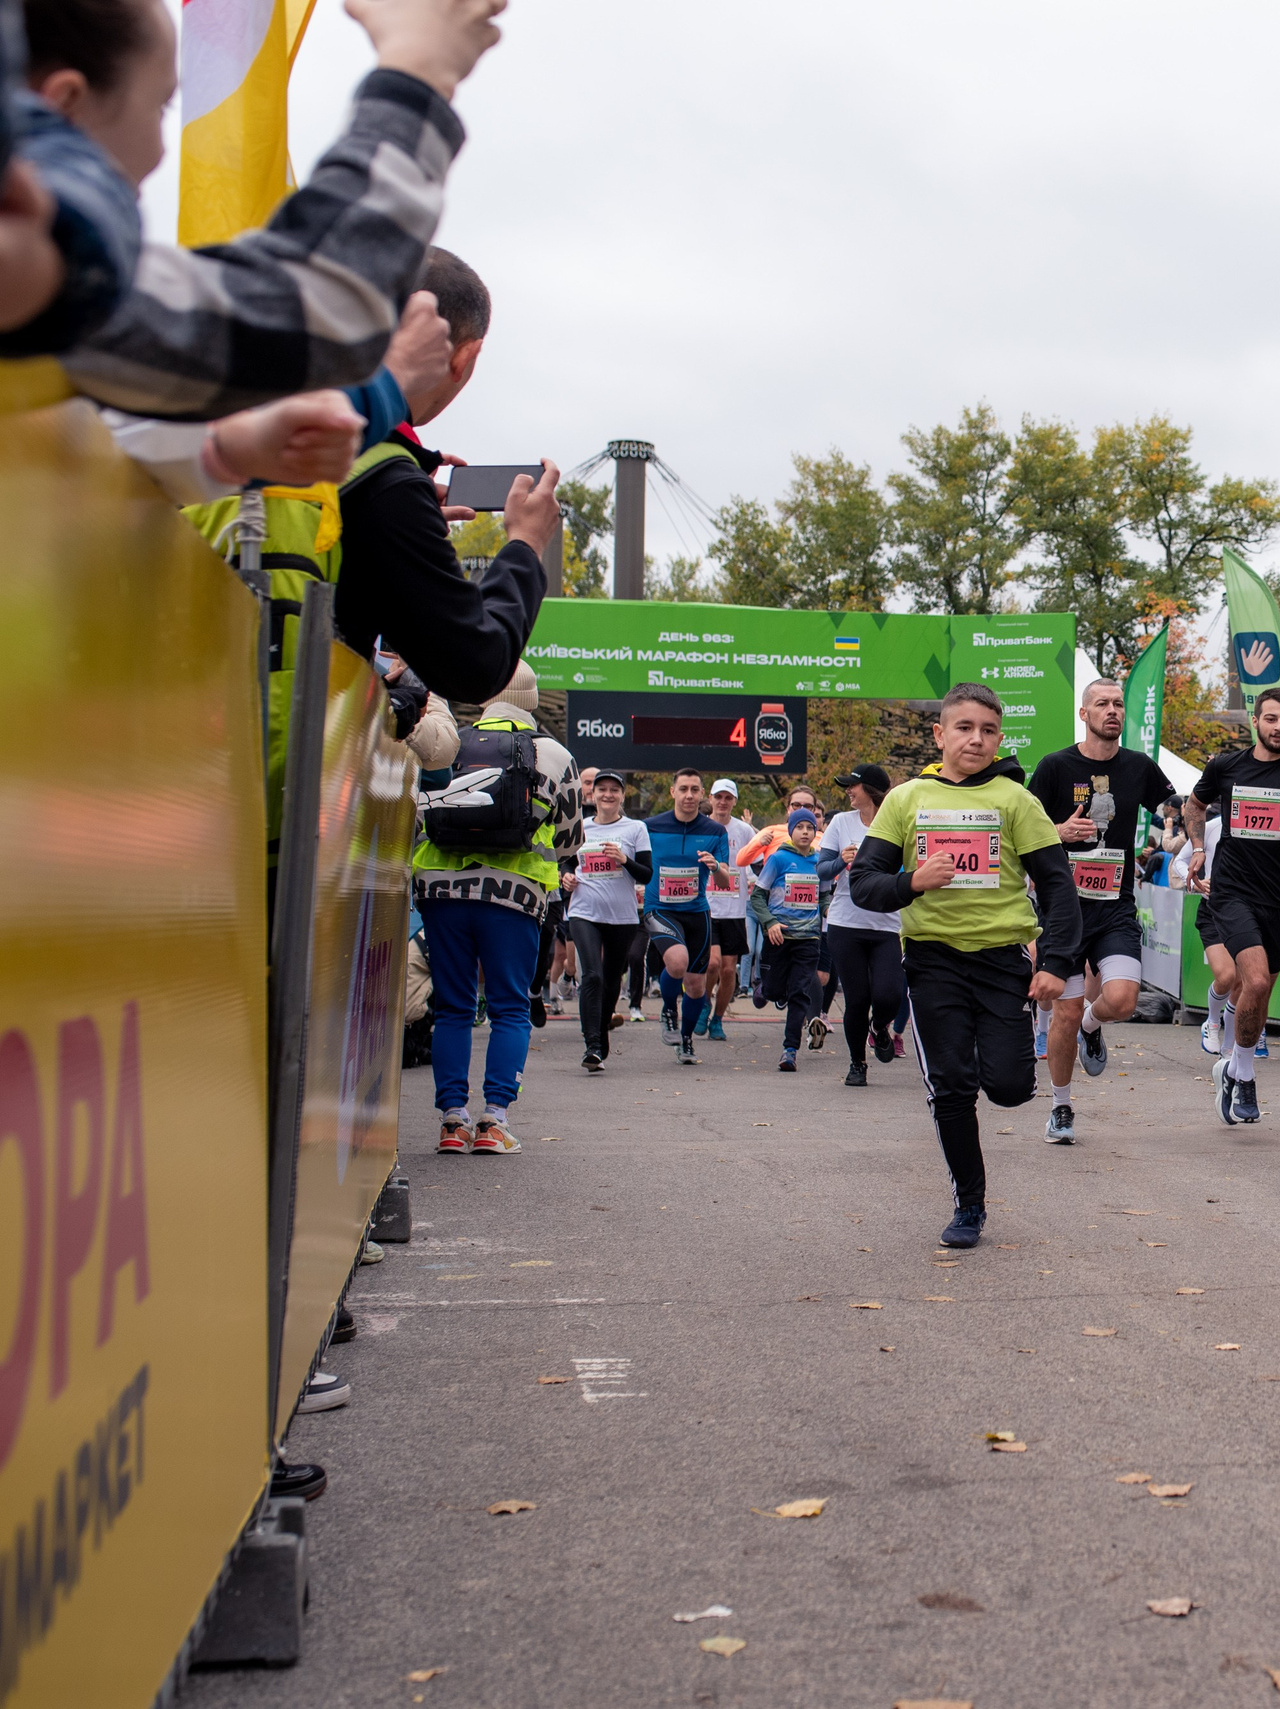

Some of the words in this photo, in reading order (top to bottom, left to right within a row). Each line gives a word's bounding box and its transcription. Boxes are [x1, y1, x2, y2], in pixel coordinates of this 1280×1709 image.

[658, 632, 700, 643] ДЕНЬ
[702, 633, 735, 643] 963:
[986, 635, 1054, 647] ПриватБанк
[525, 643, 633, 661] КИЇВСЬКИЙ
[637, 650, 729, 664] МАРАФОН
[733, 653, 861, 668] НЕЗЛАМНОСТІ
[1003, 665, 1036, 673] UNDER
[1003, 670, 1045, 678] ARMOUR
[663, 676, 744, 689] ПриватБанк
[576, 719, 625, 738] Ябко
[729, 717, 747, 748] 4
[758, 728, 787, 741] Ябко
[1244, 815, 1274, 830] 1977
[589, 861, 611, 872] 1858
[1079, 875, 1107, 890] 1980
[667, 886, 689, 897] 1605
[794, 892, 813, 903] 1970
